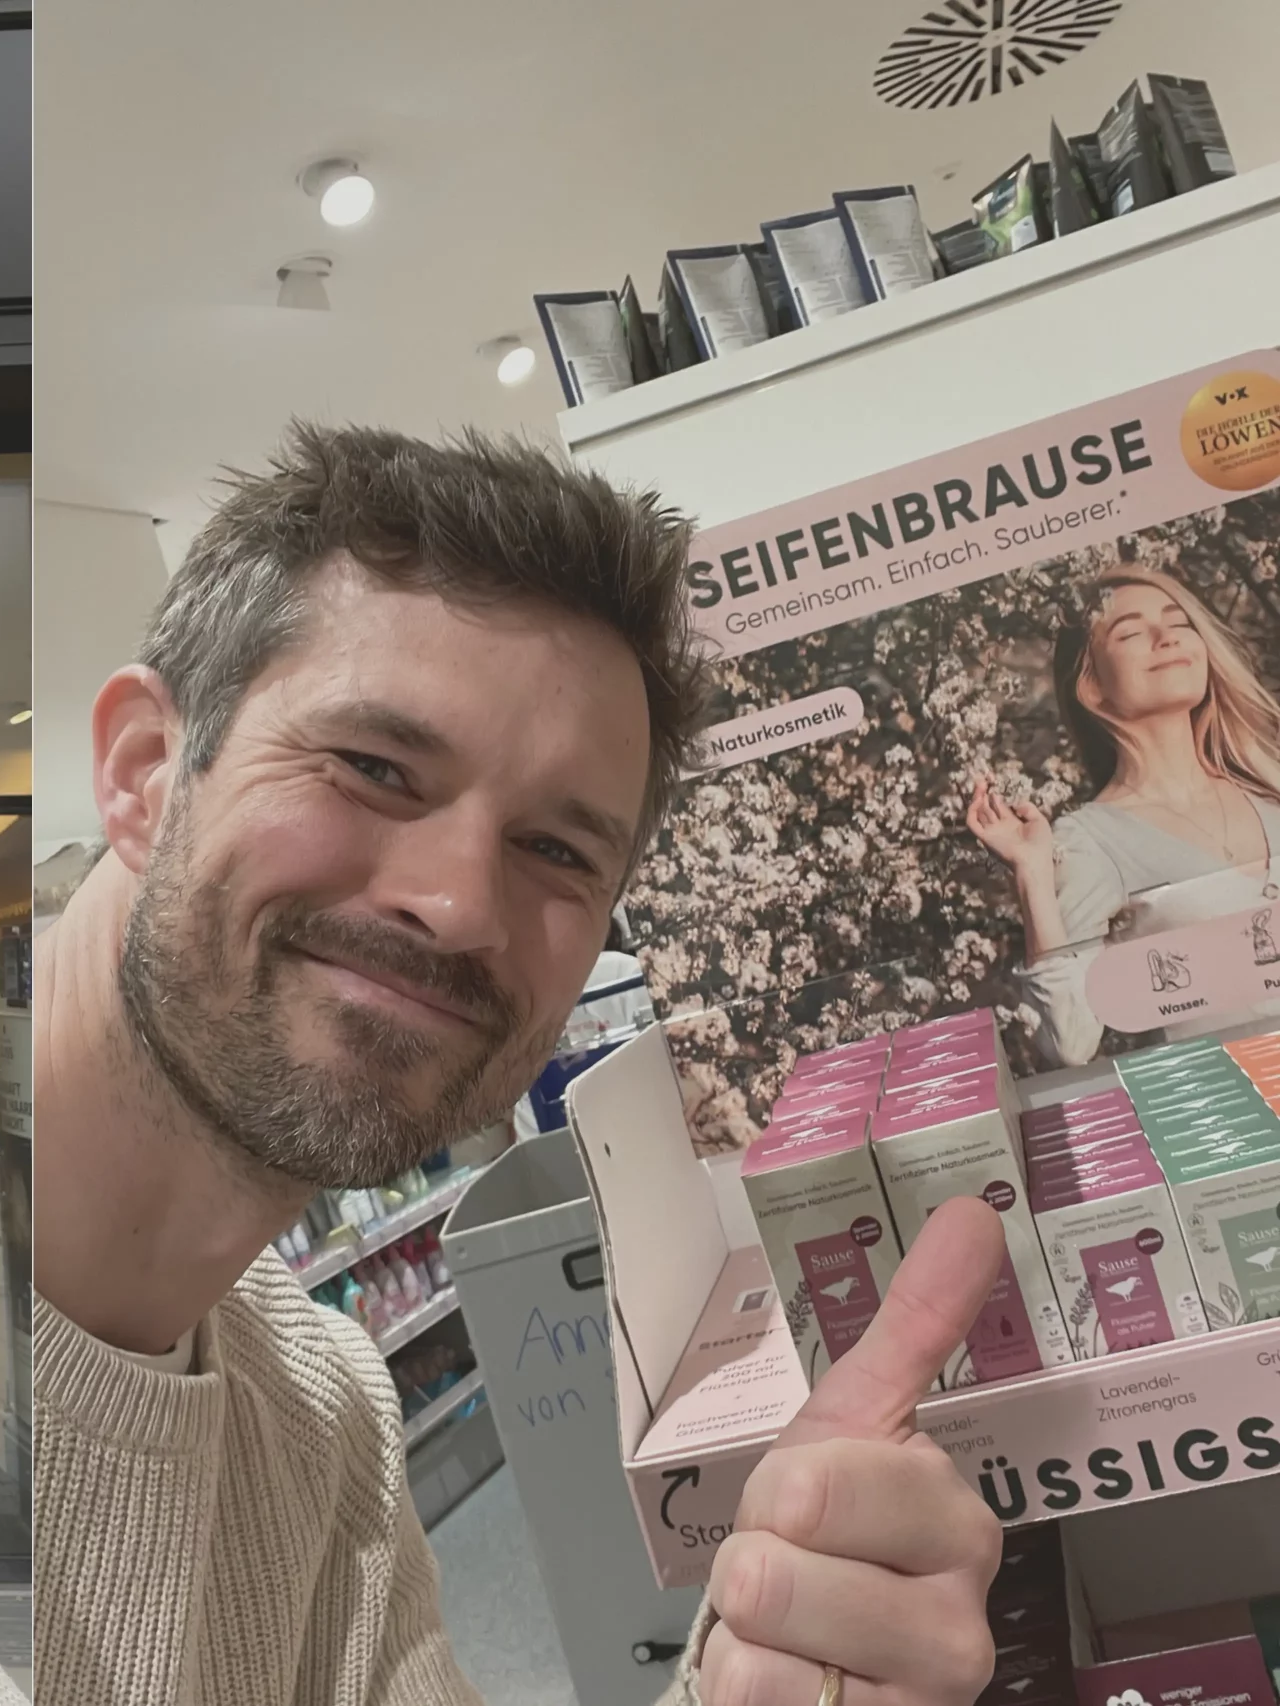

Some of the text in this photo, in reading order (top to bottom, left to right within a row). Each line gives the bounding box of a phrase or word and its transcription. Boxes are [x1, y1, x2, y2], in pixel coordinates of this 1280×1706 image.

[687, 419, 1153, 609] SEIFENBRAUSE
[725, 573, 882, 634] Gemeinsam.
[887, 540, 989, 586] Einfach.
[710, 702, 847, 755] Naturkosmetik
[1158, 998, 1208, 1016] Wasser.
[889, 1165, 940, 1183] Zertifizierte
[1238, 1226, 1280, 1243] Sause
[811, 1249, 854, 1267] Sause
[1098, 1257, 1138, 1273] Sause
[699, 1327, 786, 1351] Starter
[1100, 1373, 1181, 1401] Lavendel-
[517, 1389, 586, 1427] von
[676, 1400, 787, 1429] hochwertiger
[1096, 1391, 1197, 1422] Zitronengras
[978, 1417, 1280, 1520] ÜSSIGS
[1160, 1685, 1203, 1701] weniger
